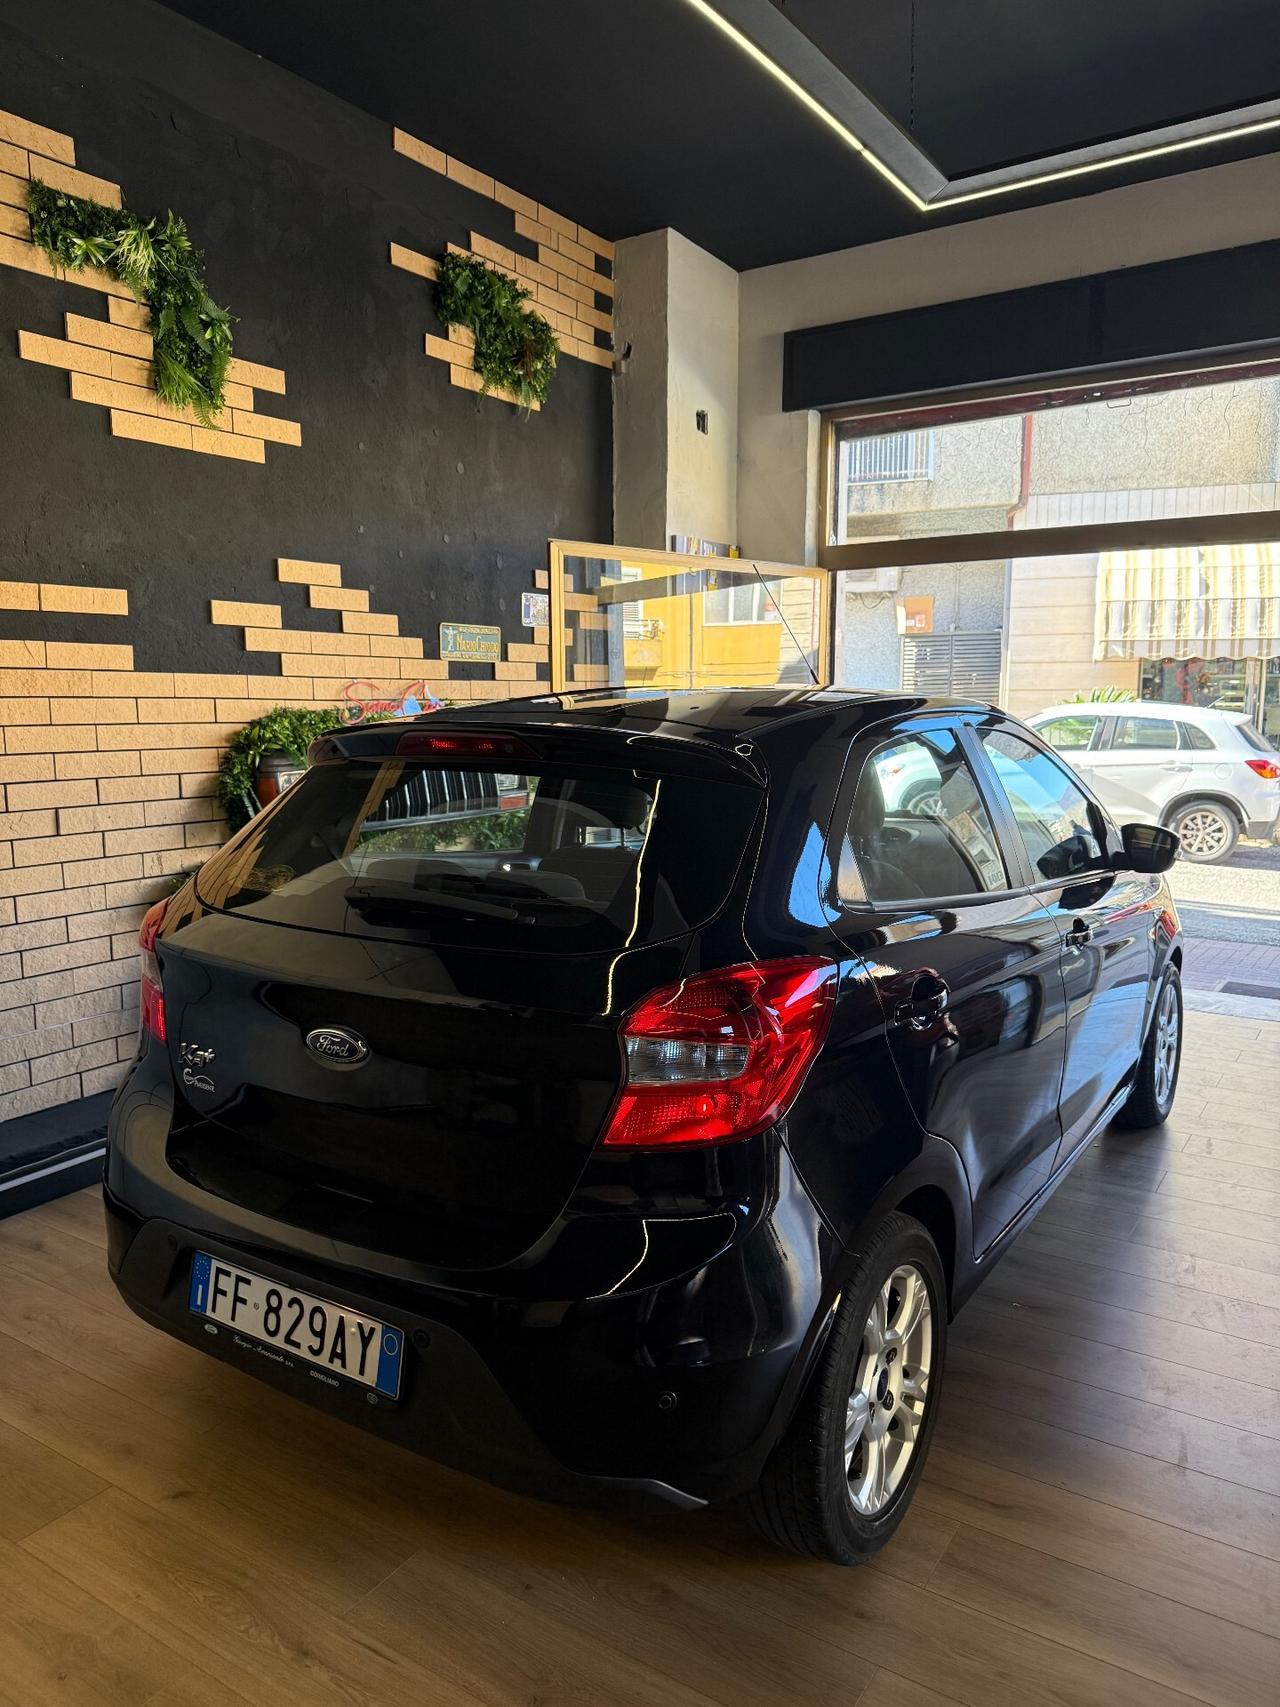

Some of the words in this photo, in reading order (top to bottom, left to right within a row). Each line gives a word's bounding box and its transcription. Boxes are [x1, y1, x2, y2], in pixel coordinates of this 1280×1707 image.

[316, 1034, 349, 1057] Ford
[210, 1265, 252, 1323] FF
[263, 1288, 377, 1377] 829AY
